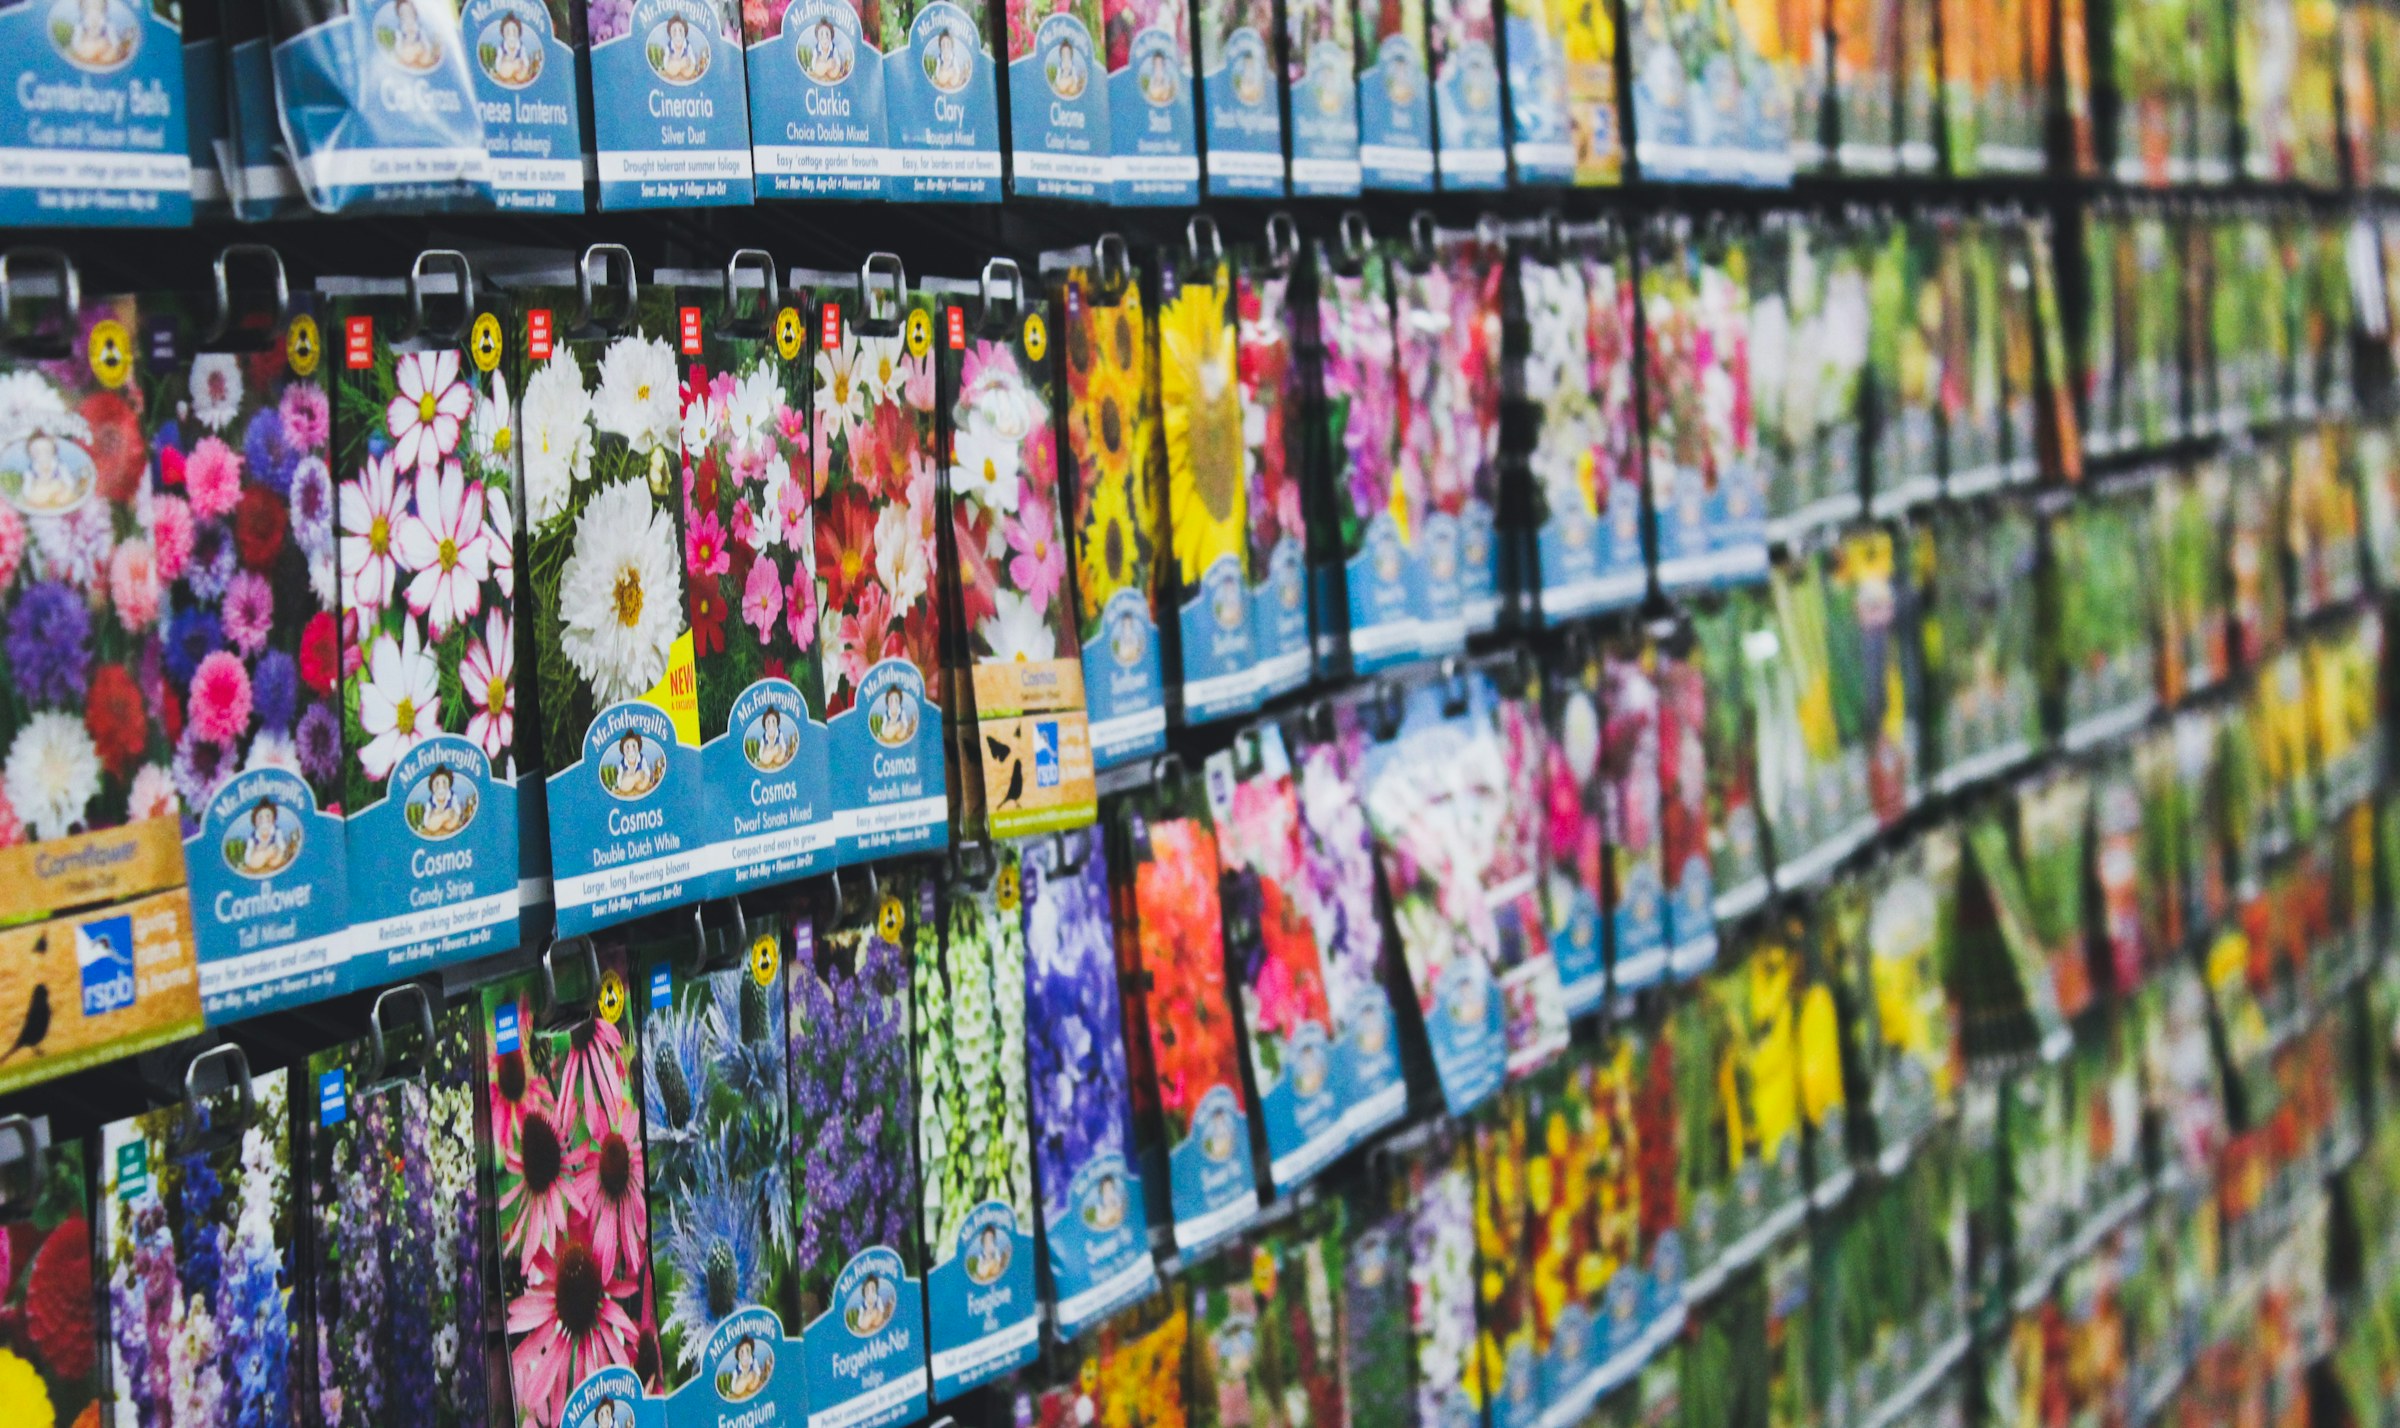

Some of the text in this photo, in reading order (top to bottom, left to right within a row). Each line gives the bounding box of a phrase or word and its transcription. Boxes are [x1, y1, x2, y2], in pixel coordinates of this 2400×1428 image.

[790, 1, 856, 36] Mr. Fothergill's
[17, 71, 170, 124] Canterbury Bells
[515, 95, 568, 126] Lanterns
[648, 89, 714, 119] Cineraria
[805, 88, 850, 117] Clarkia
[934, 95, 965, 128] Clary
[661, 125, 706, 146] Silver Dust
[786, 121, 870, 143] Choice Double Mixed
[954, 129, 976, 146] Mixed
[623, 156, 741, 176] Drought tolerant summer foliage
[776, 153, 794, 170] Easy
[851, 154, 879, 168] favourite
[670, 660, 694, 698] NEW
[1021, 667, 1058, 687] Cosmos
[737, 685, 801, 727] Mr. Fothergill's
[592, 709, 669, 753] Mr. Fothergill's
[398, 742, 482, 789] Mr. Fothergill's
[872, 751, 917, 780] Cosmos
[750, 778, 798, 807] Cosmos
[608, 807, 664, 837] Cosmos
[734, 802, 813, 836] Dwarf Sonata Mixed
[593, 833, 681, 868] Double Dutch White
[732, 843, 762, 861] Compact
[763, 840, 776, 853] and
[777, 838, 792, 853] easy
[801, 833, 817, 848] grow
[411, 848, 473, 879] Cosmos
[582, 860, 691, 899] Large, long flowering blooms
[215, 879, 313, 924] Cornflower
[409, 878, 474, 908] Candy Stripe
[261, 916, 298, 945] Mixed
[378, 902, 502, 943] Reliable, striking border plant
[84, 969, 135, 1014] rspb
[709, 1315, 776, 1365] Mr. Fothergill's
[832, 1328, 910, 1379] Forget-Me-Not
[567, 1373, 636, 1428] Mr. Fothergill's
